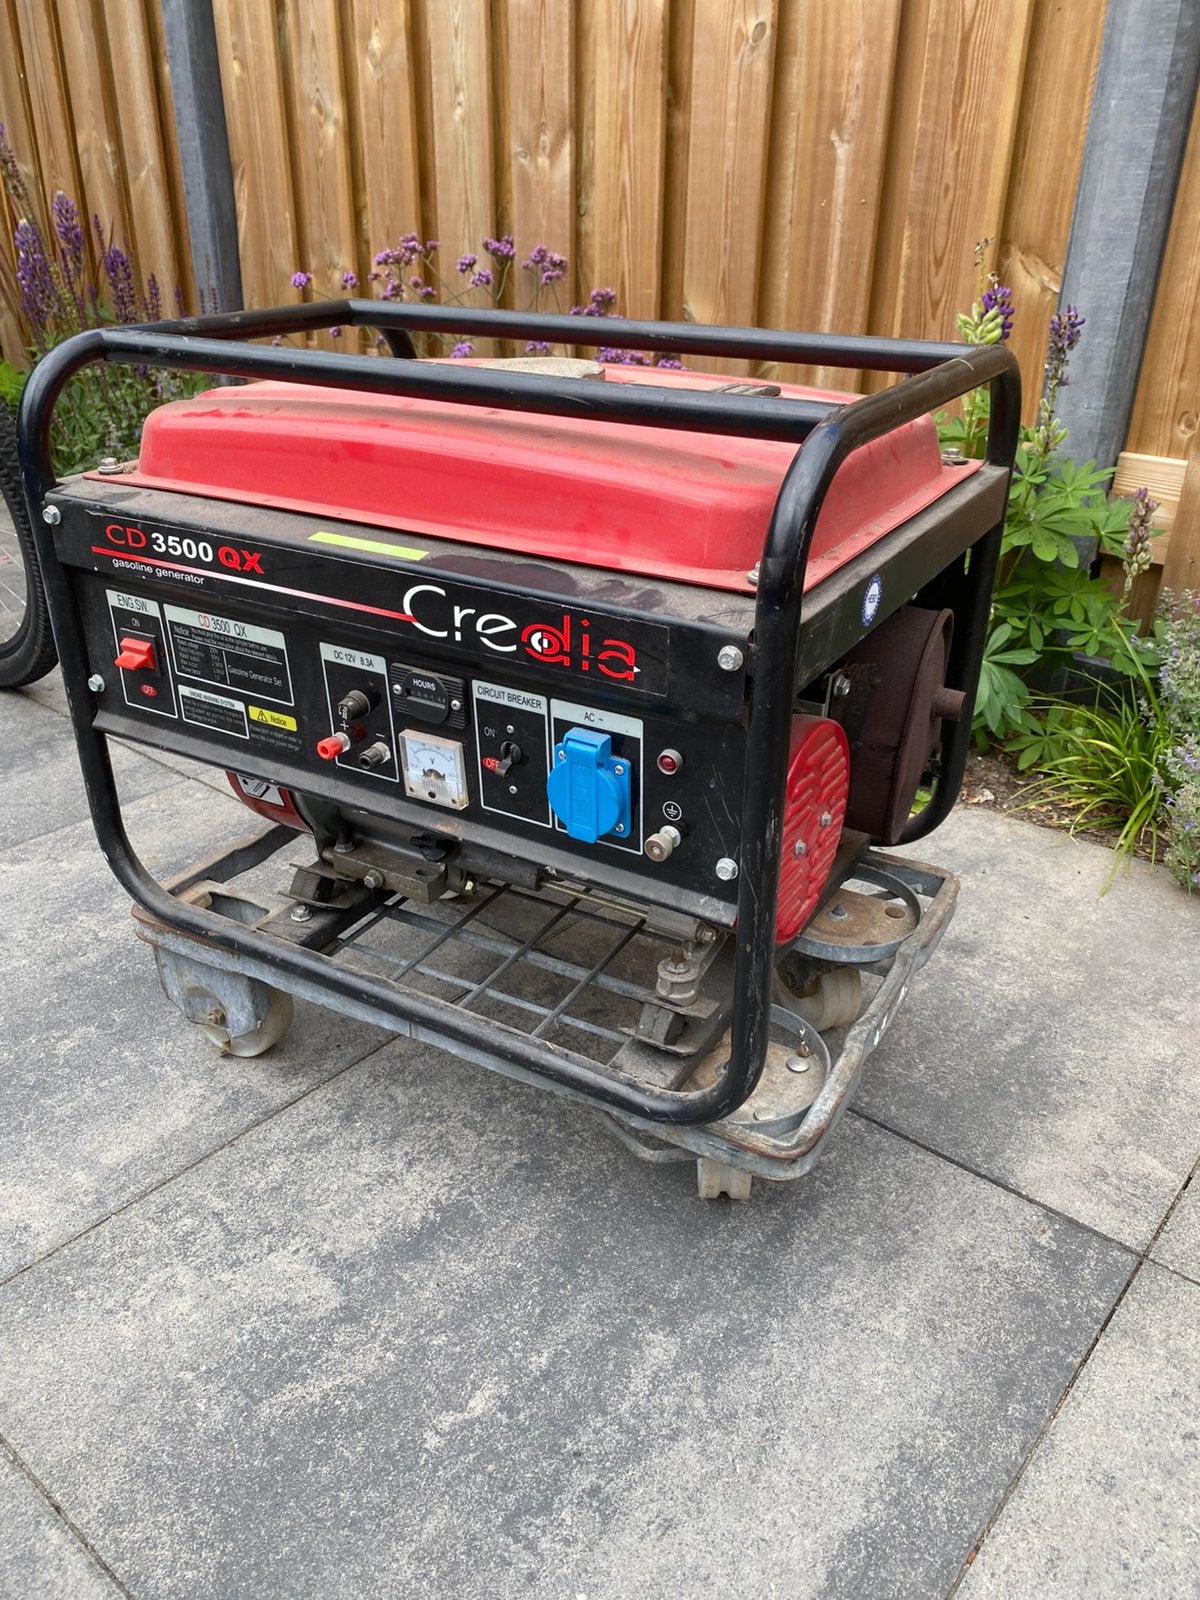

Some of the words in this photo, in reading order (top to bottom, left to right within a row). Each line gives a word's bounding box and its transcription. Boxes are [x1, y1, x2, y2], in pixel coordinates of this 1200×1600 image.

[105, 524, 147, 548] CD
[151, 532, 214, 562] 3500
[218, 545, 265, 574] QX
[112, 557, 153, 574] gasoline
[155, 566, 205, 585] generator
[197, 614, 211, 629] CD
[211, 617, 231, 634] 3500
[233, 623, 248, 638] QX
[403, 584, 637, 682] Credia
[333, 650, 344, 661] DC
[344, 653, 356, 664] 12V
[360, 656, 375, 669] 8.3A
[412, 678, 437, 692] HOURS
[477, 685, 506, 701] CIRCUIT
[507, 692, 543, 710] BREAKER
[270, 714, 288, 728] Notice
[583, 711, 595, 723] AC
[484, 726, 496, 738] ON
[430, 756, 436, 765] V
[486, 758, 500, 769] OFF
